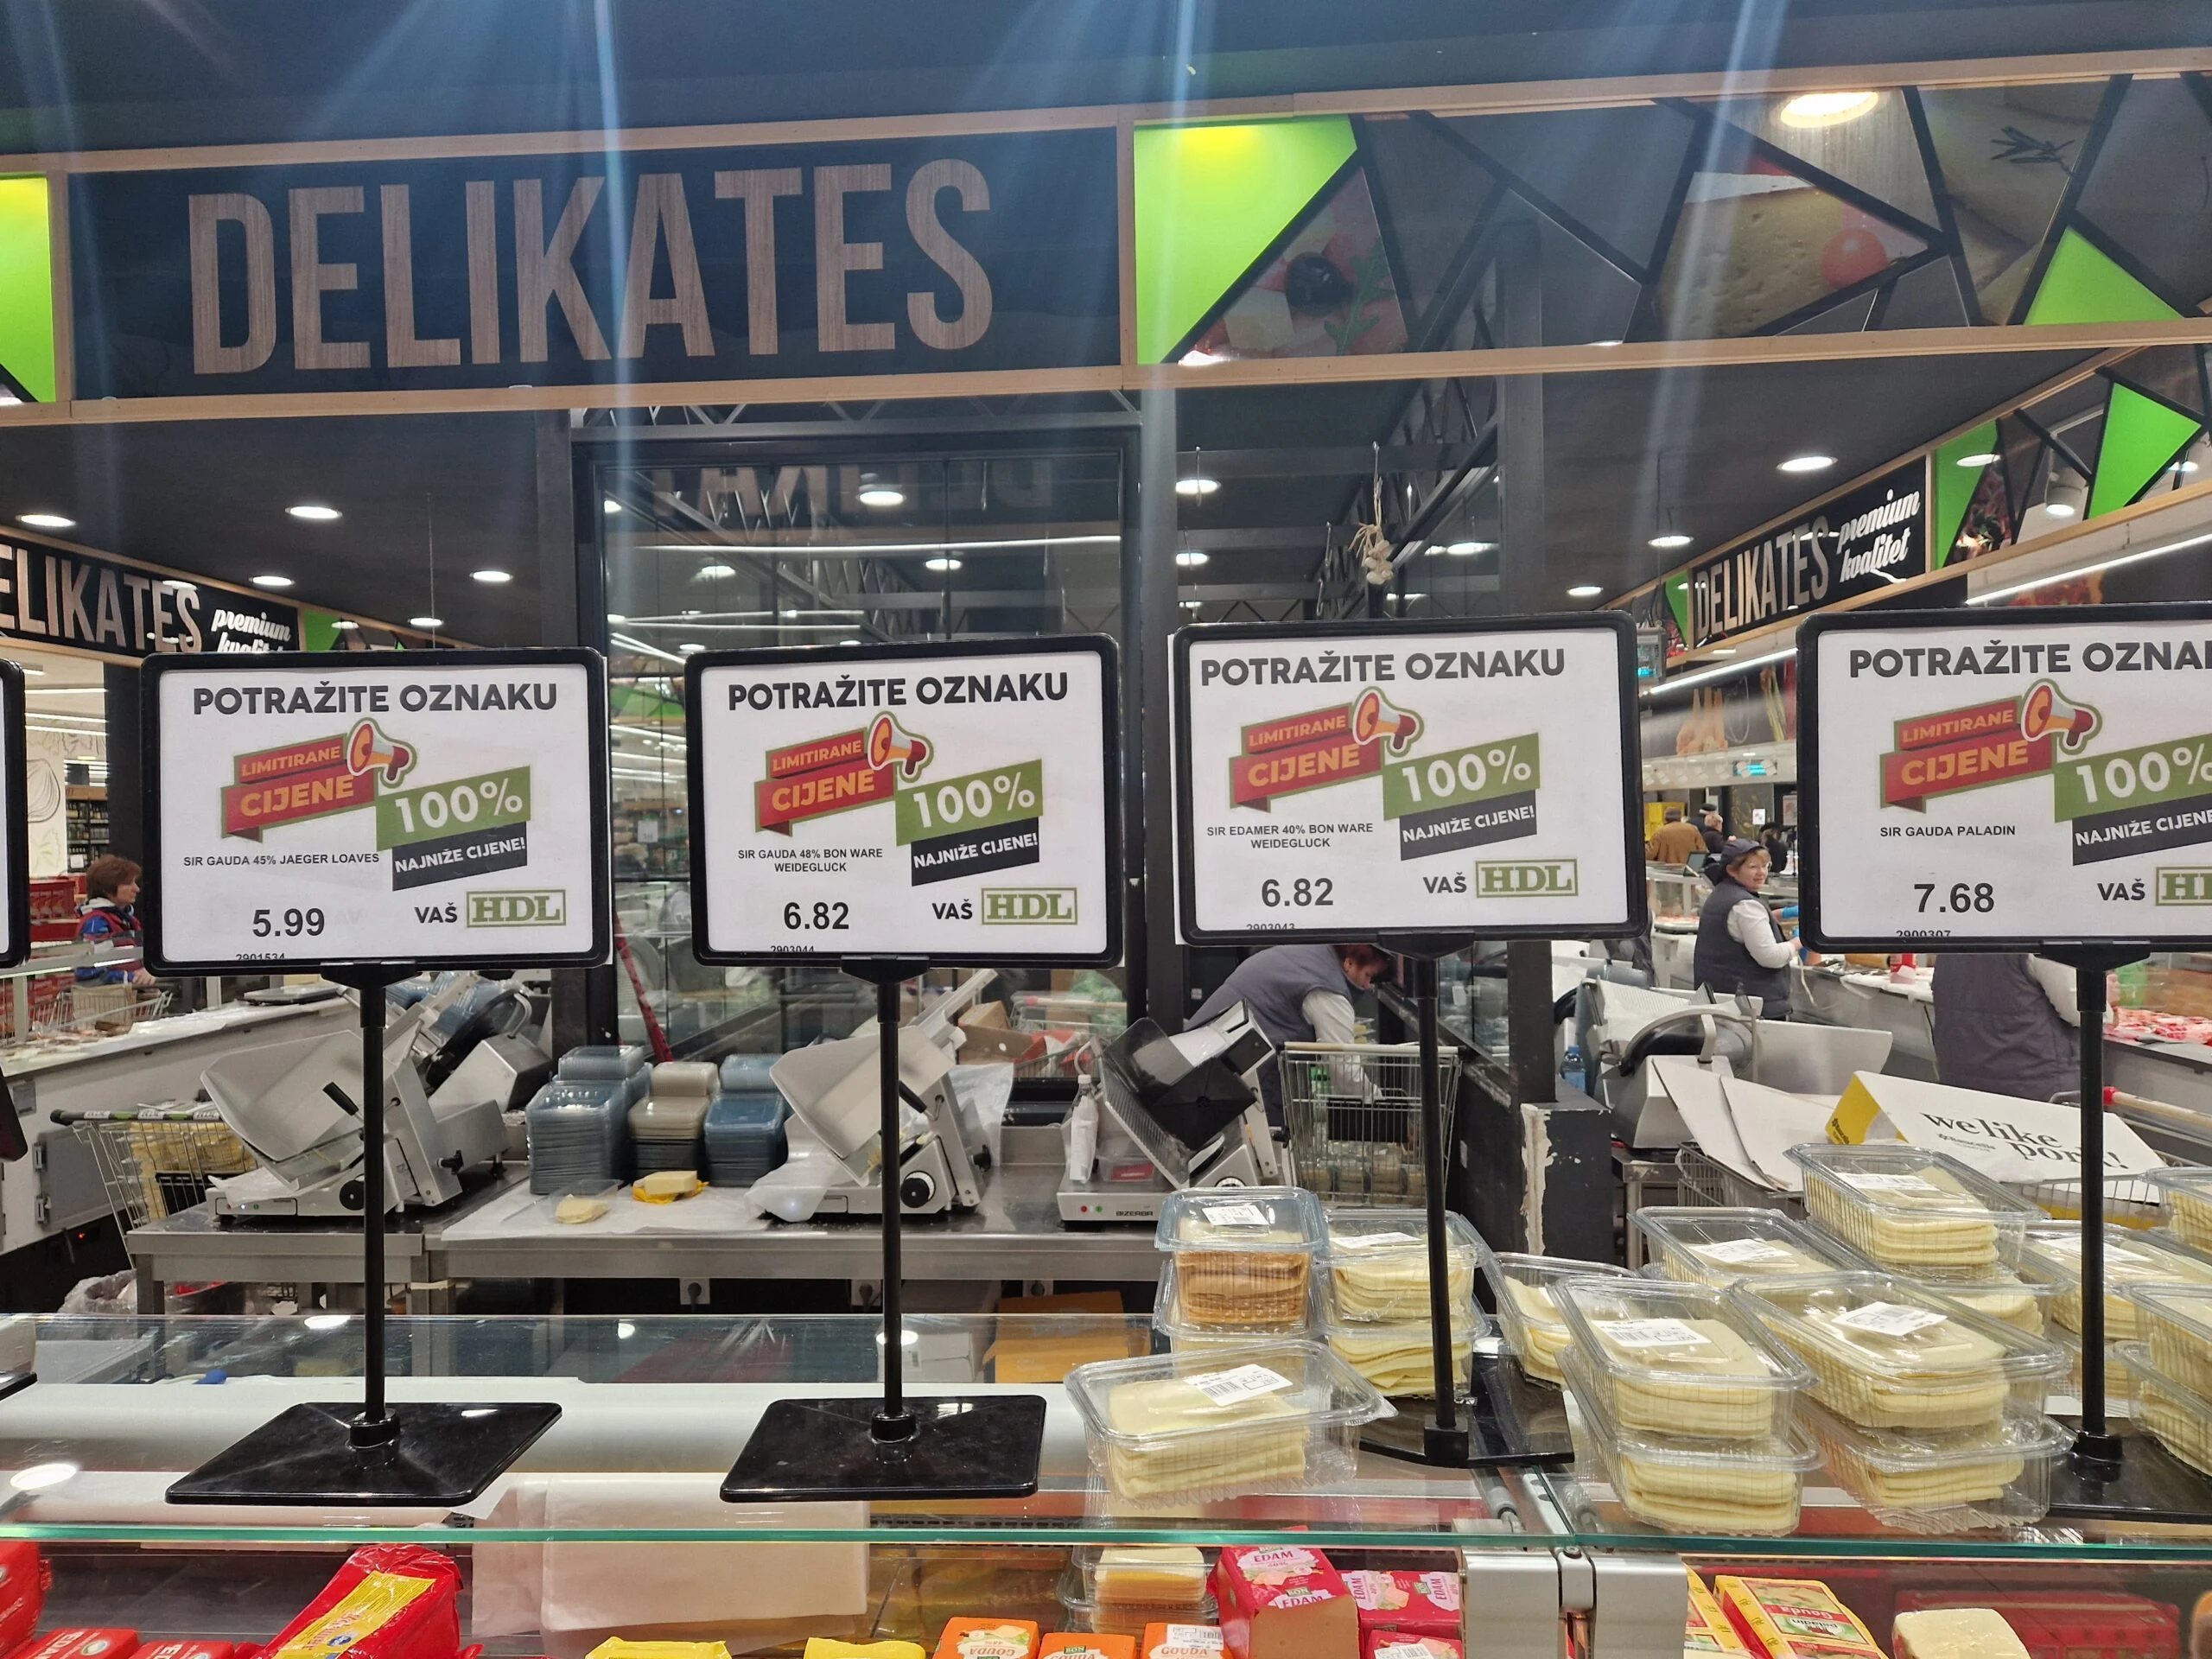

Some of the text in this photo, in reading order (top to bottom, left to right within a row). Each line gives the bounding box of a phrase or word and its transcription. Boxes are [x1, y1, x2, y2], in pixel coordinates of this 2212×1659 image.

[188, 158, 993, 374] DELIKATES
[1837, 489, 1920, 554] premium
[1840, 527, 1910, 582] kvalitet
[1696, 516, 1829, 639] DELIKATES
[211, 609, 290, 641] premium
[1201, 648, 1566, 686] POTRAŽITE OZNAKU
[1850, 639, 2071, 677] POTRAŽITE
[194, 681, 557, 715] POTRAŽITE OZNAKU
[728, 671, 1069, 710] POTRAŽITE OZNAKU
[1249, 715, 1345, 747] LIMITIRANE
[1902, 709, 2014, 743] LIMITIRANE
[241, 746, 340, 777] LIMITIRANE
[772, 740, 861, 772] LIMITIRANE
[1248, 744, 1360, 787] CIJENE
[1902, 741, 2029, 785] CIJENE
[1402, 746, 1531, 803] 100%
[2076, 743, 2212, 804] 100%
[240, 774, 354, 817] CIJENE
[395, 779, 523, 833] 100%
[772, 769, 874, 812] CIJENE
[913, 772, 1035, 829] 100%
[1207, 822, 1373, 836] SIR EDAMER 40% BON WARE
[1402, 805, 1535, 843] NAJNIŽE CIJENE!
[1880, 825, 2016, 837] SIR GAUDA PALADIN
[2075, 818, 2152, 847] NAJNIŽE
[395, 836, 526, 873] NAJNIŽE CIJENE!
[738, 848, 883, 860] SIR GAUDA 48% BON WARE
[913, 832, 1039, 869] NAJNIŽE CIJENE!
[1250, 837, 1331, 849] WEIDEGLUCK
[183, 853, 379, 866] SIR GAUDA 45% JAEGER LOAVES
[774, 862, 847, 873] WEIDEGLUCK
[1262, 878, 1334, 907] 6.82
[1423, 864, 1573, 893] VAŠ HDL
[2097, 879, 2145, 901] VAŠ
[415, 896, 560, 923] VAŠ HDL
[931, 893, 1071, 920] VAŠ HDL
[1914, 883, 1994, 913] 7.68
[252, 908, 325, 938] 5.99
[784, 902, 849, 931] 6.82
[2005, 1141, 2129, 1170] por!
[1254, 1550, 1294, 1562] EDAM
[1351, 1578, 1366, 1599] EDAM
[1430, 1579, 1447, 1600] EDAM
[1781, 1607, 1833, 1619] Gouda
[969, 1647, 1016, 1656] GOUDA
[1161, 1647, 1208, 1656] GOUDA
